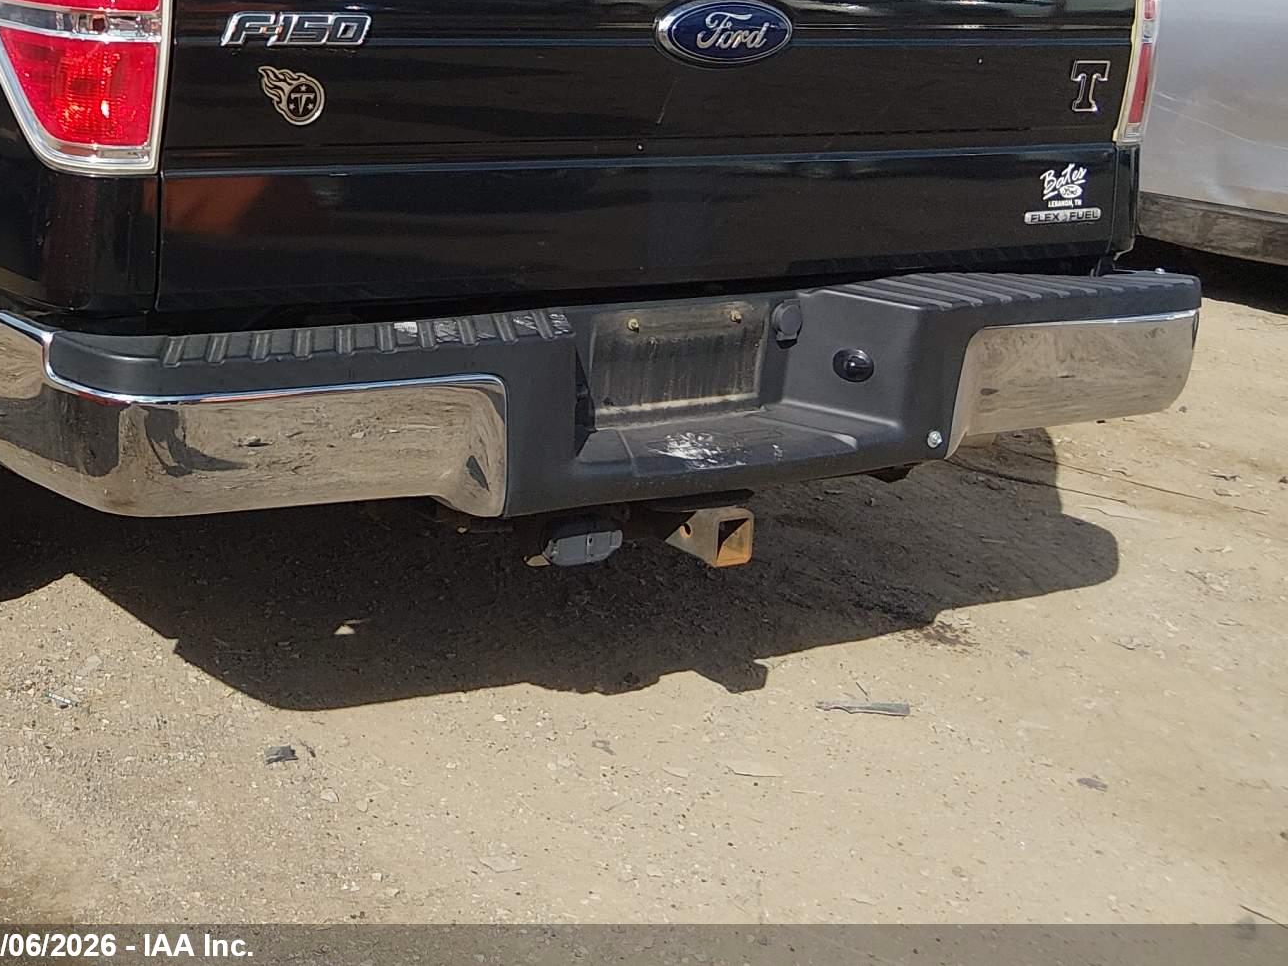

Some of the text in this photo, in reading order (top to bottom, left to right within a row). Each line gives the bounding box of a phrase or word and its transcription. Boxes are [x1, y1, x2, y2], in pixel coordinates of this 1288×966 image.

[220, 11, 373, 47] F-150
[696, 11, 768, 50] Ford
[1071, 60, 1111, 112] T
[1039, 162, 1088, 195] Bates
[1030, 210, 1099, 223] FLEX FUEL
